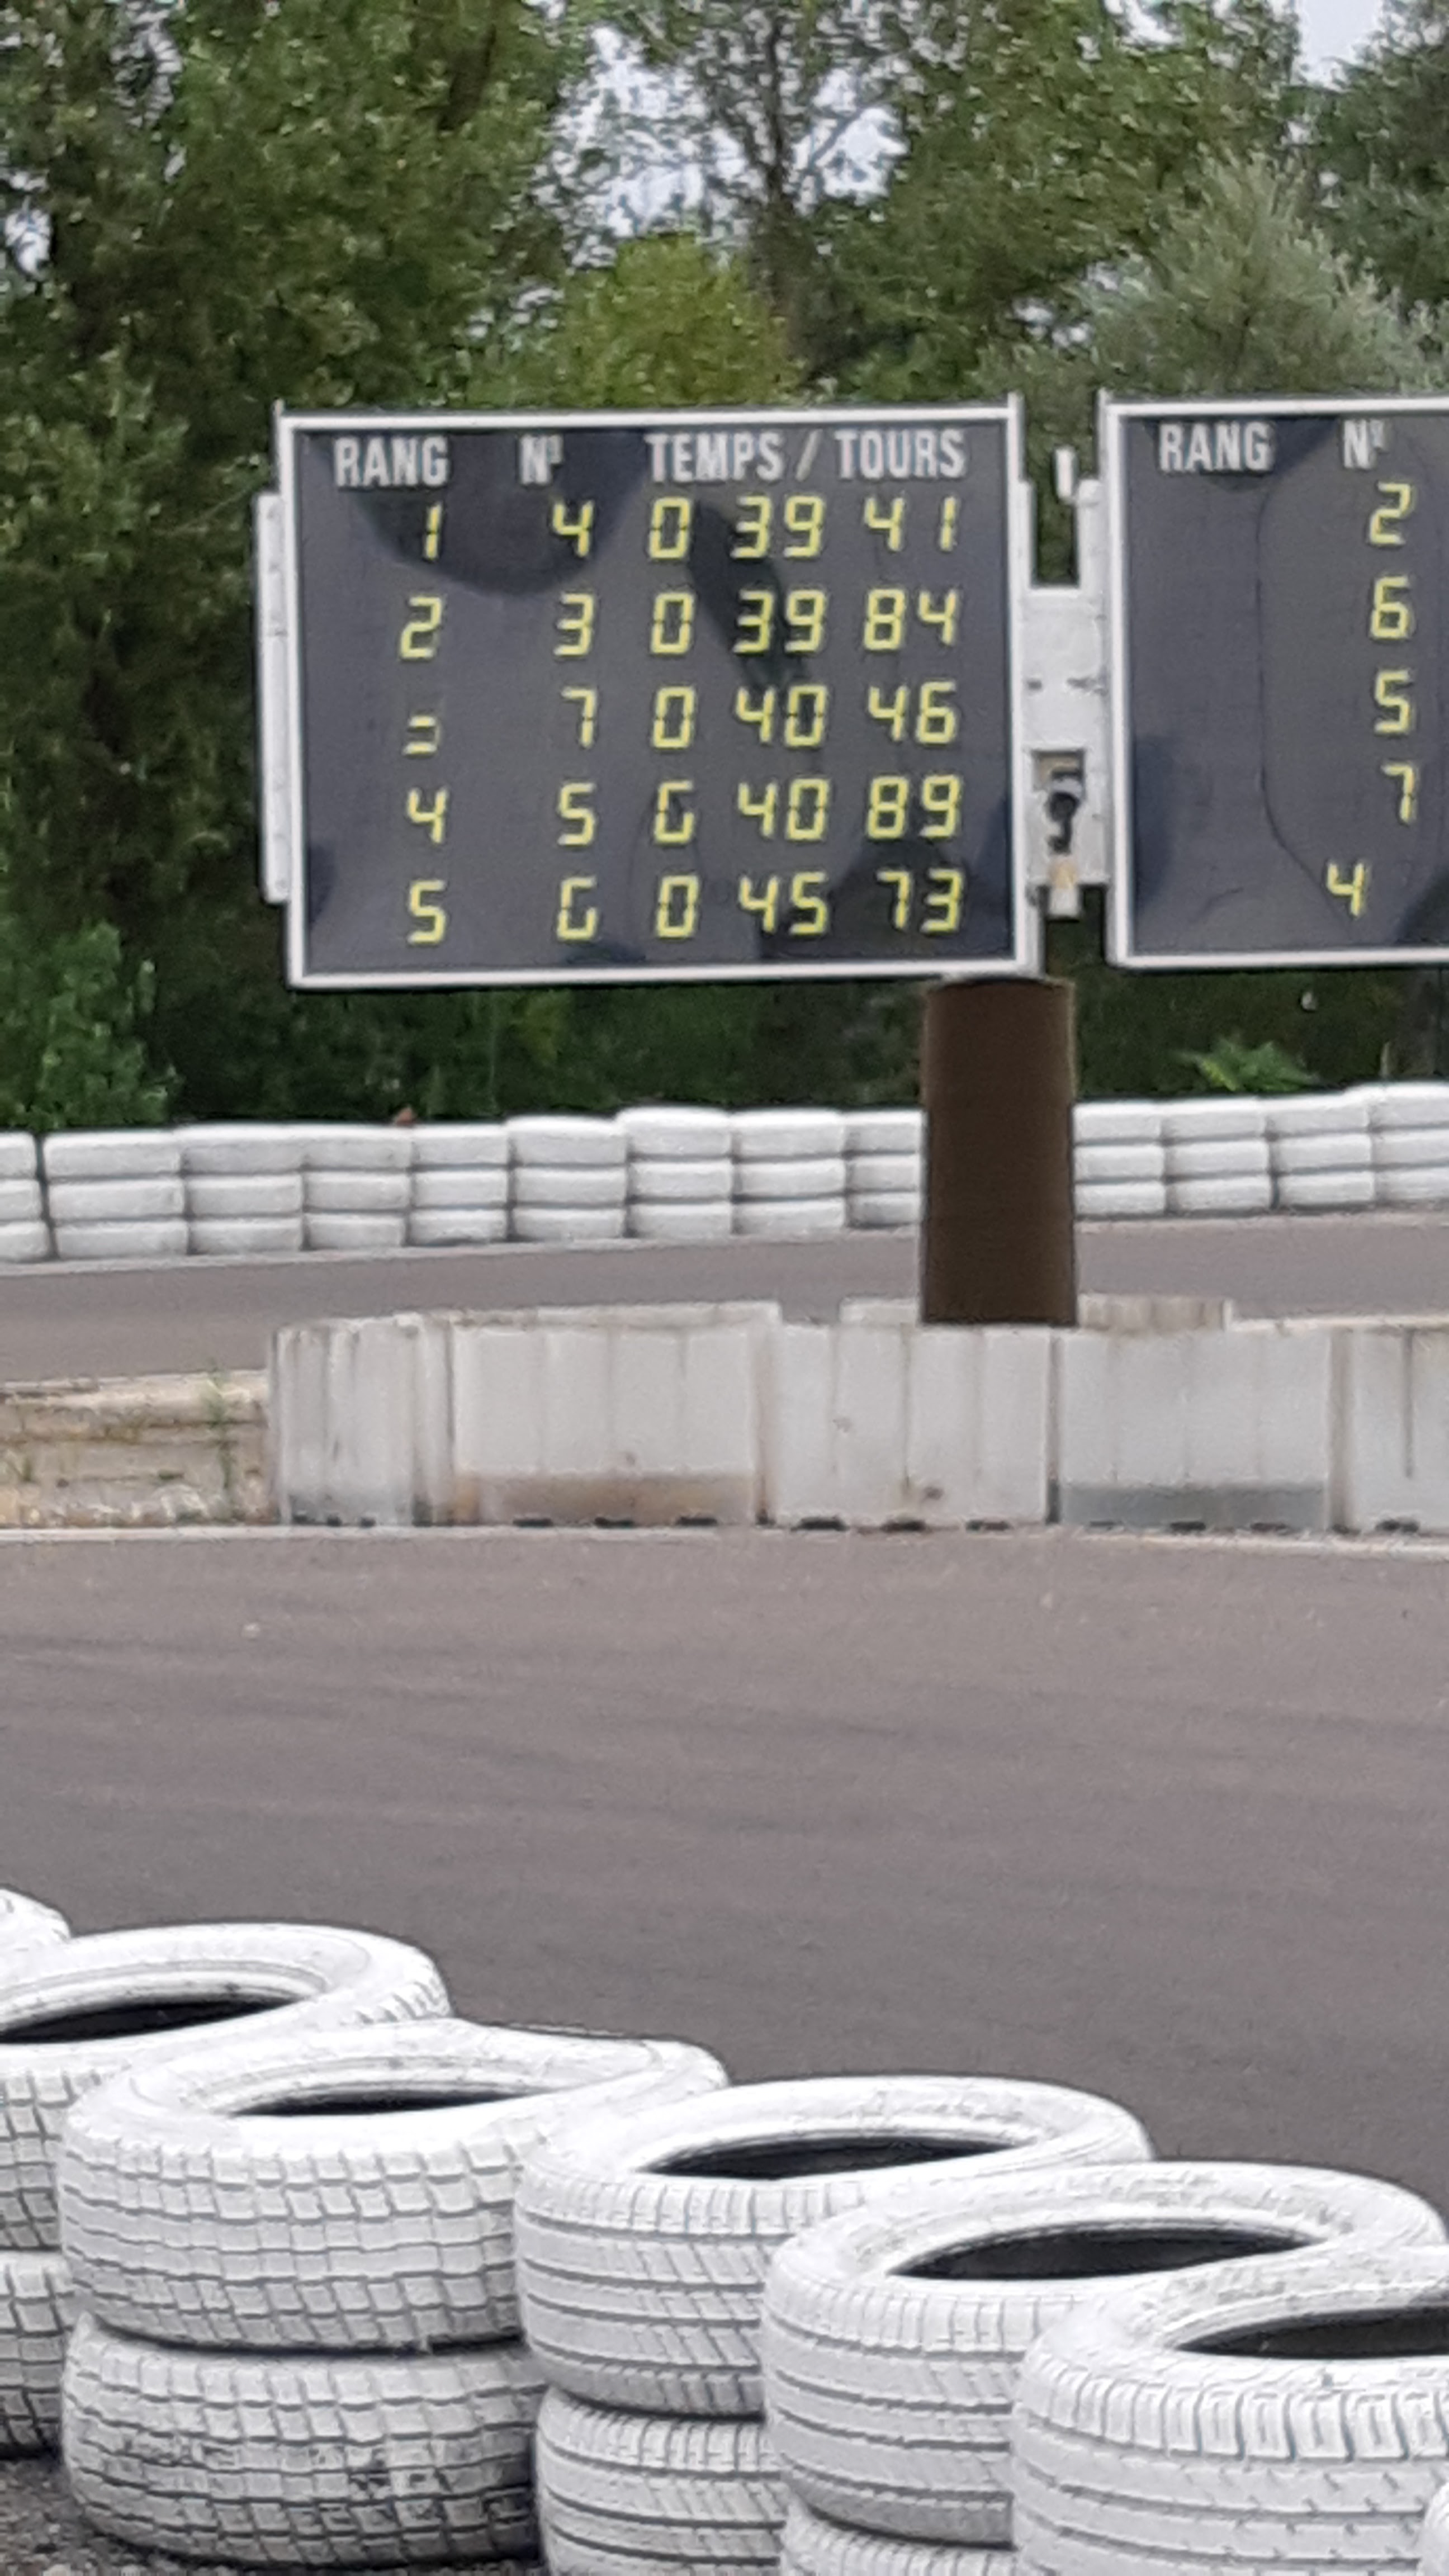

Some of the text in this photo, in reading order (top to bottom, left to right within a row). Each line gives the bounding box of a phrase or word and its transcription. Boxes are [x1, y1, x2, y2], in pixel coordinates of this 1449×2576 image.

[336, 437, 447, 486] RANG
[645, 430, 782, 482] TEMPS
[795, 430, 821, 481] /
[835, 429, 965, 479] TOURS
[1159, 421, 1273, 472] RANG
[424, 494, 958, 560] 1 4 0 39 41
[1370, 481, 1414, 546] 2
[399, 587, 958, 660] 2 3 0 39 84
[1370, 575, 1412, 641] 6
[560, 687, 596, 747] 7
[651, 685, 696, 750] 0
[735, 684, 828, 748] 40
[868, 680, 956, 745] 46
[1374, 670, 1413, 735] 5
[406, 788, 447, 845] 4
[557, 782, 596, 846] 5
[737, 777, 830, 841] 40
[866, 773, 963, 839] 89
[1381, 763, 1417, 823] 7
[408, 879, 447, 945] 5
[655, 874, 700, 939] 0
[739, 870, 828, 935] 45
[877, 869, 964, 934] 73
[1327, 862, 1367, 918] 4
